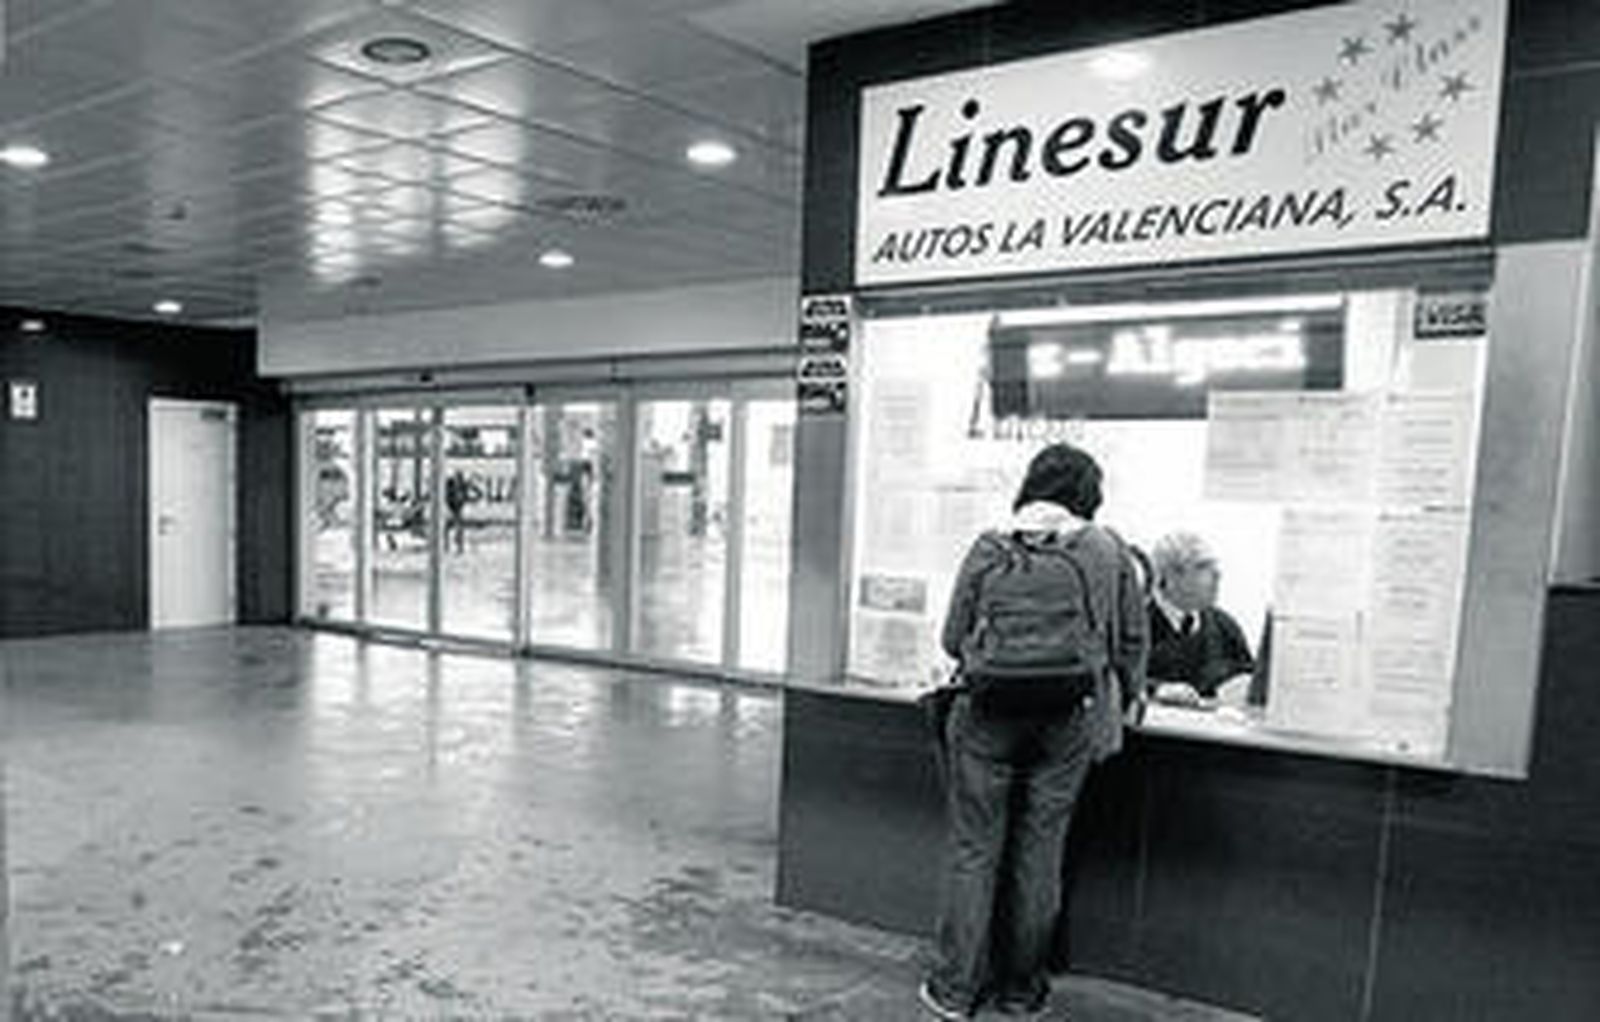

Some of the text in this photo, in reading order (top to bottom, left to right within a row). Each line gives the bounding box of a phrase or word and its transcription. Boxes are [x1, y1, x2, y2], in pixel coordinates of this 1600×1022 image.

[877, 89, 1286, 198] Linesur
[871, 174, 1466, 263] AUTOS LA VALENCIANA, S.A.
